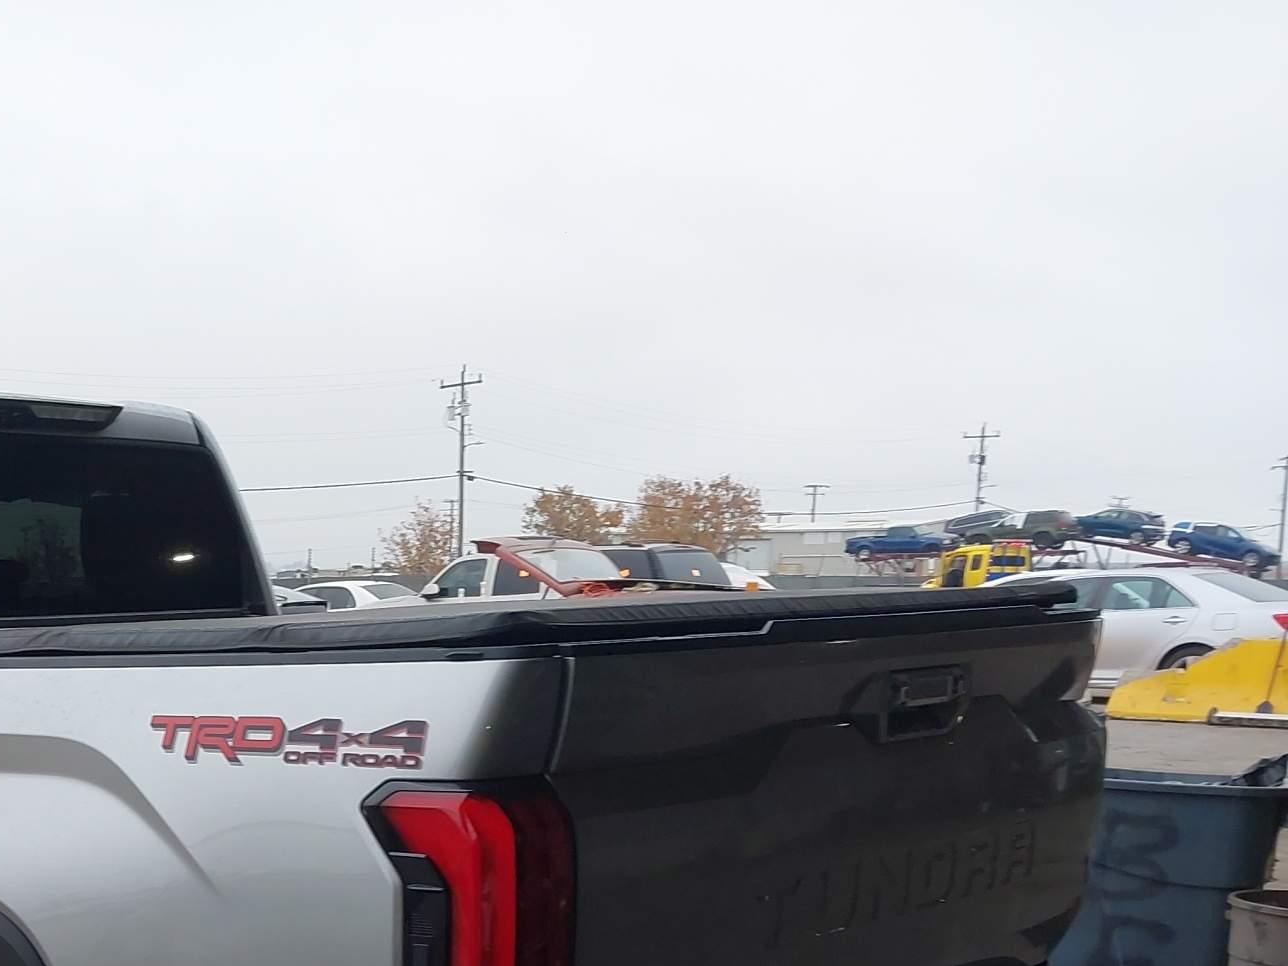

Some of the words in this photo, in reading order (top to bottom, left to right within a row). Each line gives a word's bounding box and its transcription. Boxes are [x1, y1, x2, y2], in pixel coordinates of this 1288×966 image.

[150, 715, 287, 766] TRD
[288, 718, 429, 757] 4x4
[283, 750, 338, 766] OFF
[341, 752, 423, 770] ROAD
